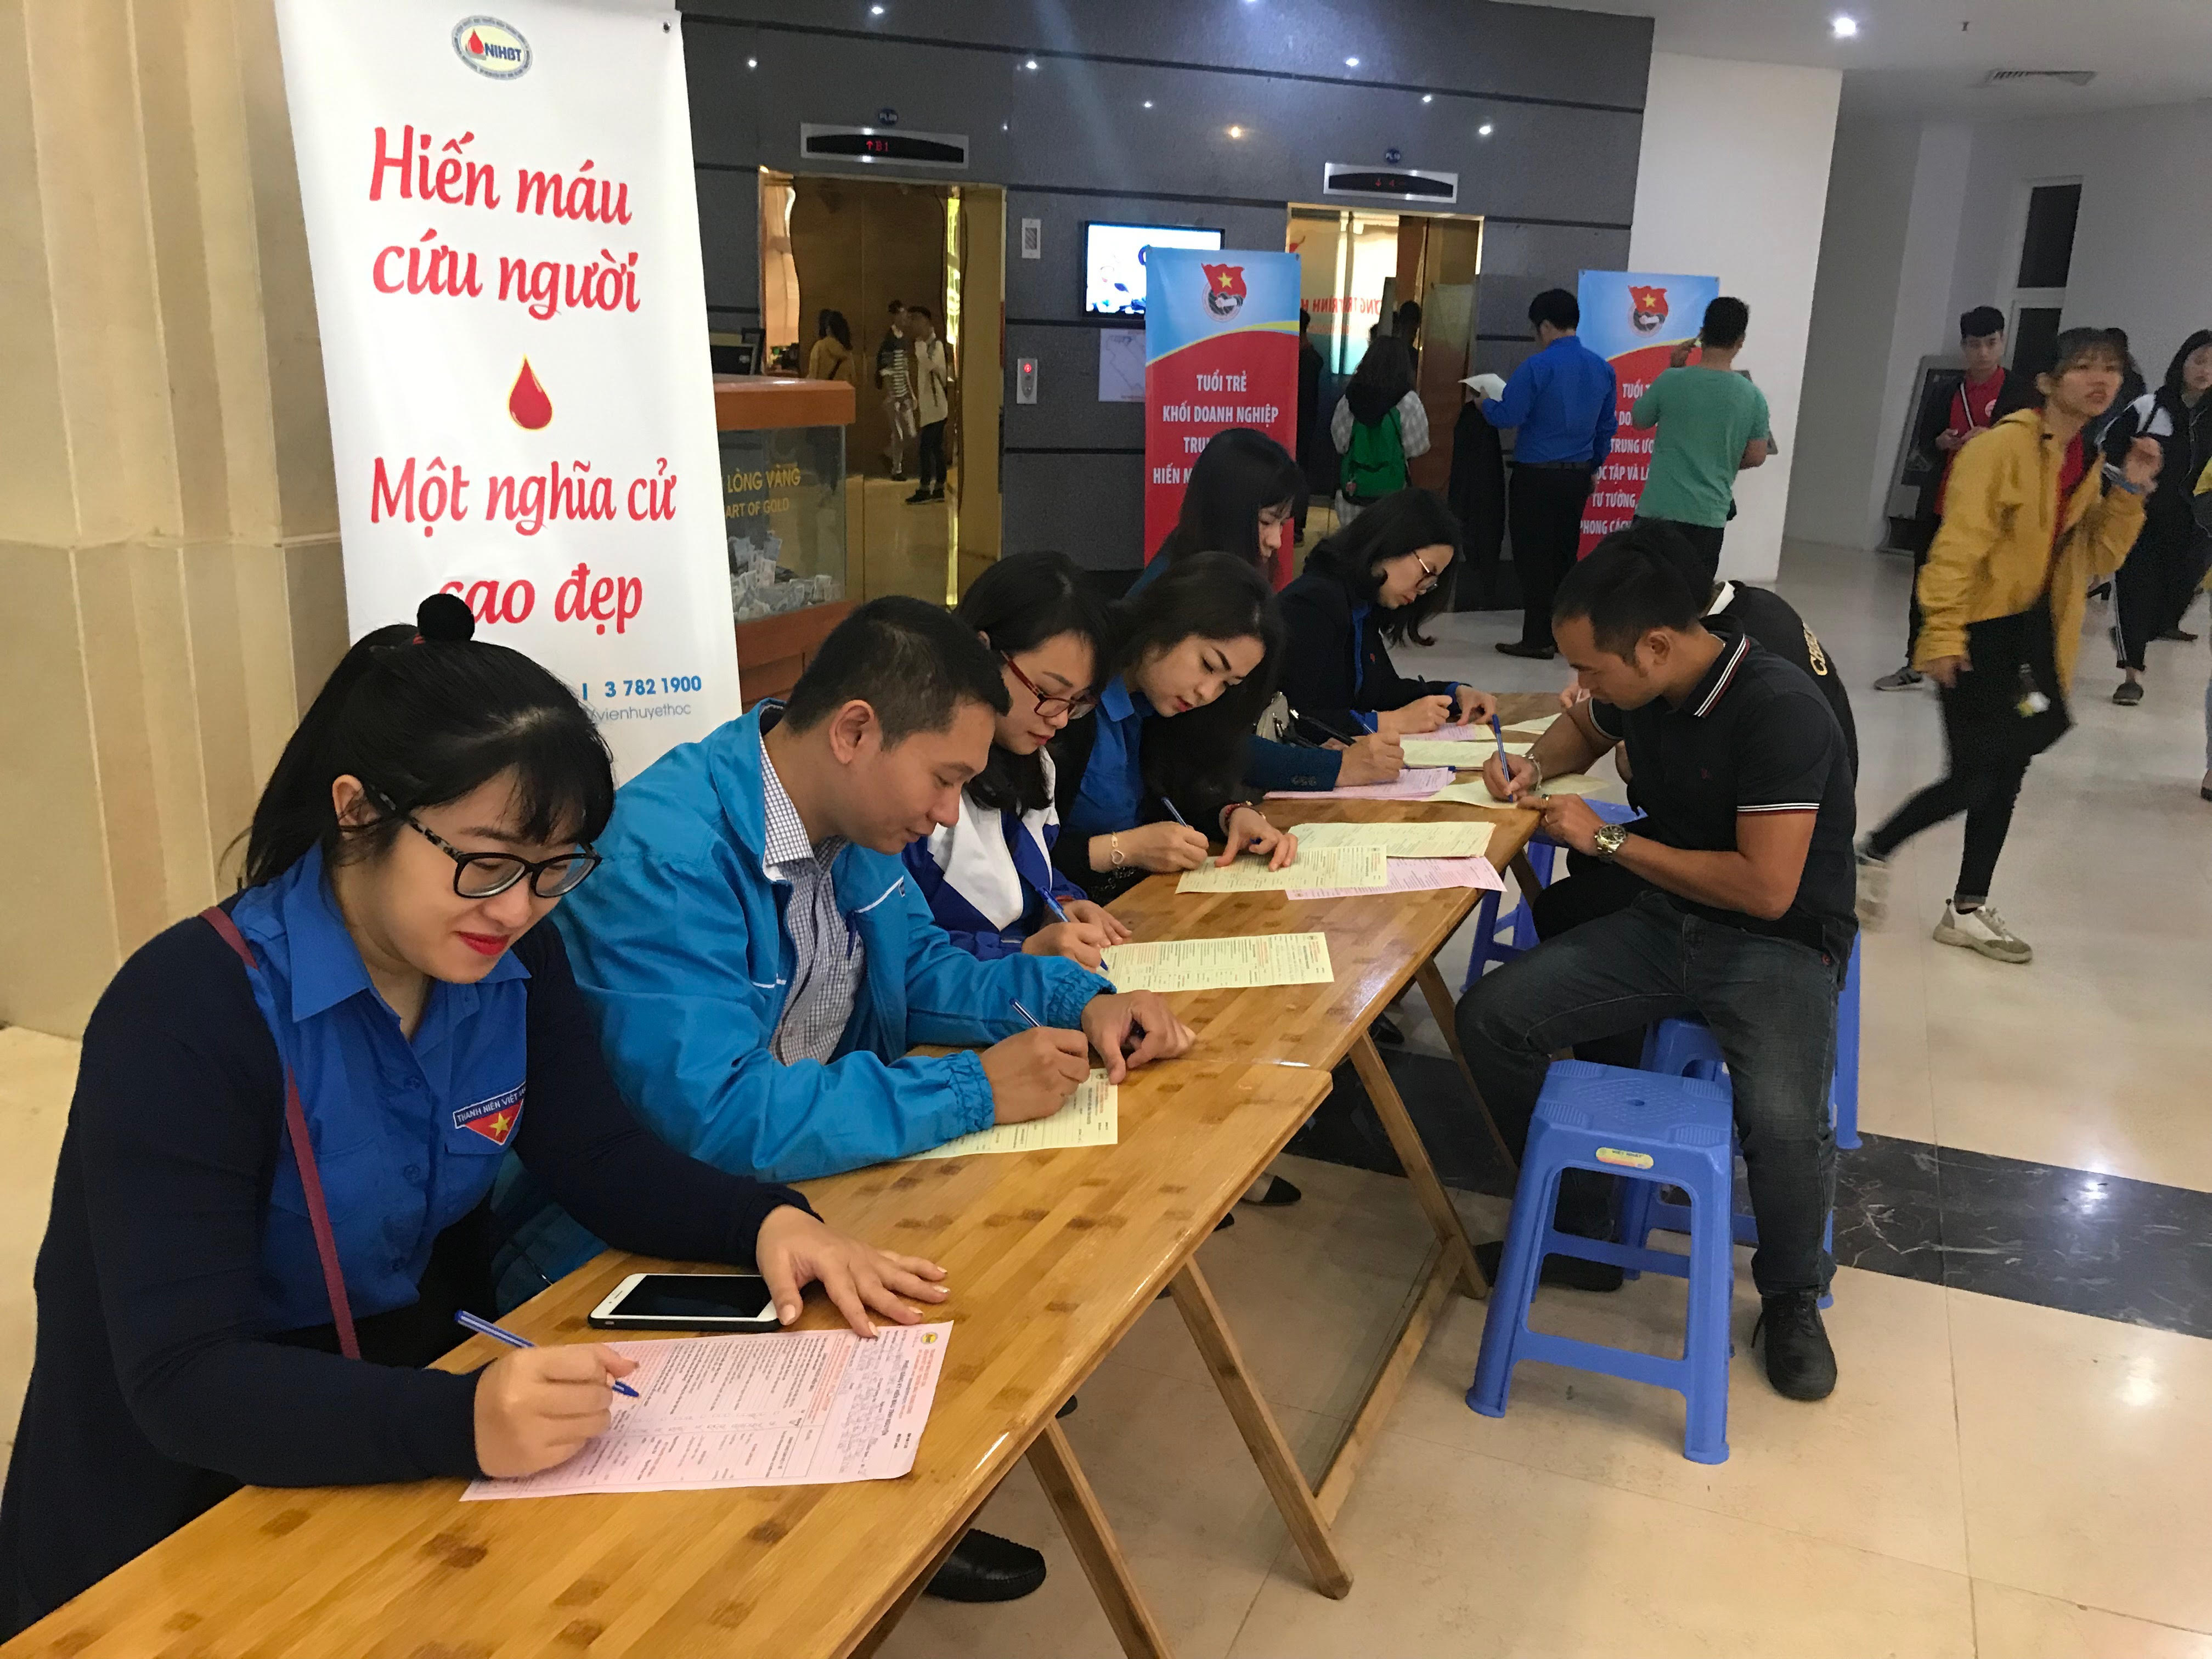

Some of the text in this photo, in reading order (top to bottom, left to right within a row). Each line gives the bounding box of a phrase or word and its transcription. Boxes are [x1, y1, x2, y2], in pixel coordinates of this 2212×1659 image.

[484, 42, 522, 62] NIHBT
[369, 125, 633, 225] Hiến máu
[373, 228, 641, 320] cứu người
[1197, 369, 1247, 392] TUỔI TRẺ
[1163, 400, 1279, 427] KHỐI DOANH NGHIỆP
[1610, 438, 1639, 453] TRUNG
[727, 465, 801, 493] LÒNG VÀNG
[1153, 463, 1180, 484] HIẾN
[1609, 463, 1625, 484] TẬP
[1627, 464, 1638, 481] VÀ
[370, 456, 677, 537] Một nghĩa cử
[748, 500, 760, 516] OF
[763, 498, 789, 514] GOLD
[1593, 491, 1604, 507] TƯ
[555, 562, 643, 636] đẹp
[605, 681, 617, 697] 3
[623, 679, 656, 696] 782
[661, 675, 702, 693] 1900
[457, 1108, 482, 1122] THANH
[483, 1101, 501, 1113] NIÊN
[501, 1093, 517, 1106] VIỆT
